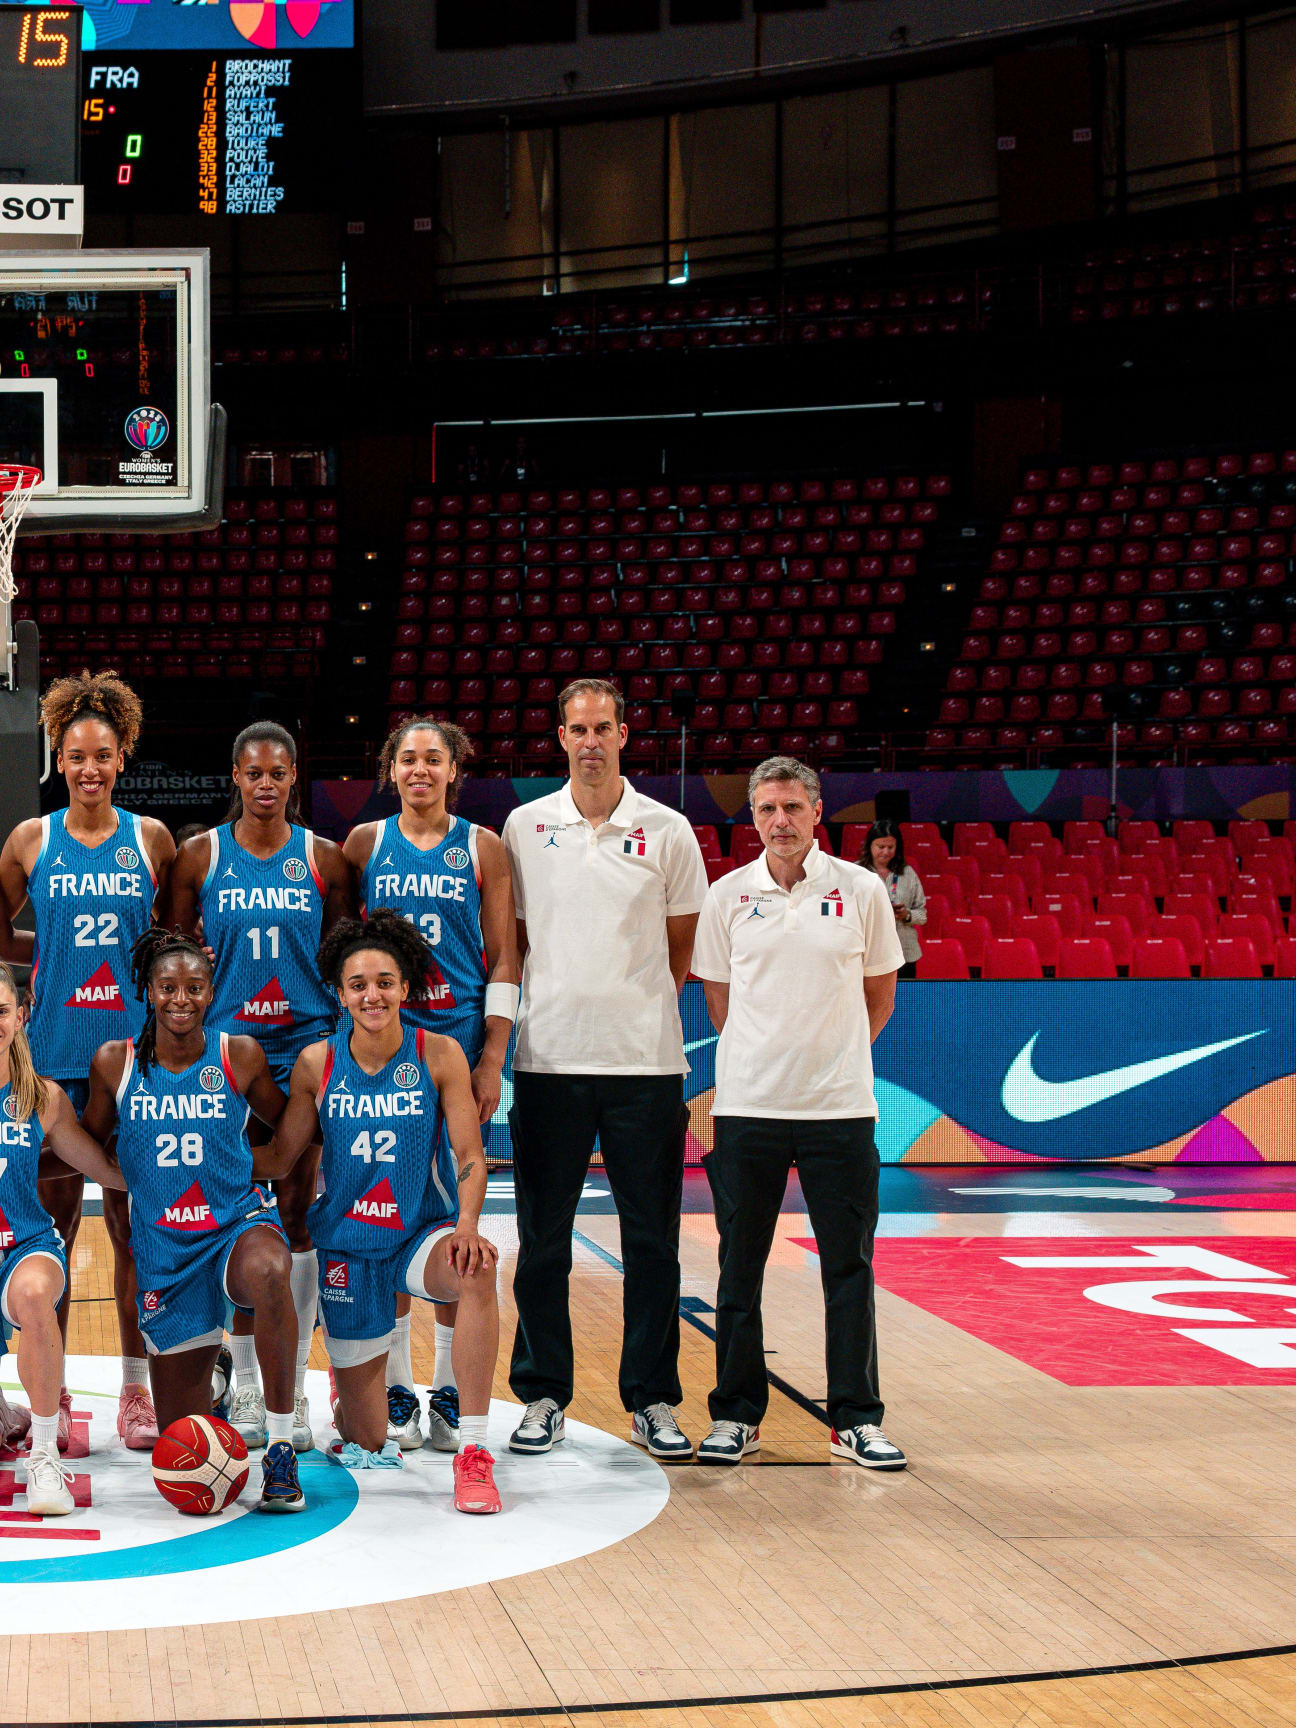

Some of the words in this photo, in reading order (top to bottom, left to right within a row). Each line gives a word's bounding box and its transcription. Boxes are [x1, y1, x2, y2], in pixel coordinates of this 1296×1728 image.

[225, 59, 292, 73] BROCHANT
[90, 66, 140, 89] FRA
[225, 72, 291, 86] FOPPOSSI
[226, 85, 266, 98] AYAYI
[226, 98, 276, 112] RUPERT
[226, 111, 276, 124] SALAUN
[226, 123, 284, 137] BADIANE
[126, 134, 142, 157] 0
[226, 136, 267, 150] TOURE
[225, 149, 268, 162] POUYE
[117, 164, 132, 184] 0
[225, 161, 275, 175] DJALDI
[226, 175, 268, 187] LACAN
[226, 187, 284, 201] BERNIES
[226, 201, 276, 214] ASTIER
[119, 462, 173, 473] EUROBASKET
[115, 776, 230, 789] OBASKET
[49, 872, 143, 898] FRANCE
[375, 873, 468, 902] FRANCE
[218, 887, 312, 913] FRANCE
[73, 912, 119, 947] 22
[246, 926, 279, 960] 11
[75, 984, 120, 1003] MAIF
[415, 984, 450, 1002] AIF
[243, 1000, 290, 1016] MAIF
[130, 1093, 227, 1121] FRANCE
[328, 1090, 424, 1118] FRANCE
[155, 1132, 204, 1167] 28
[350, 1130, 397, 1164] 42
[164, 1204, 210, 1223] MAIF
[352, 1199, 398, 1218] MAIF
[324, 1288, 346, 1296] CAISSE
